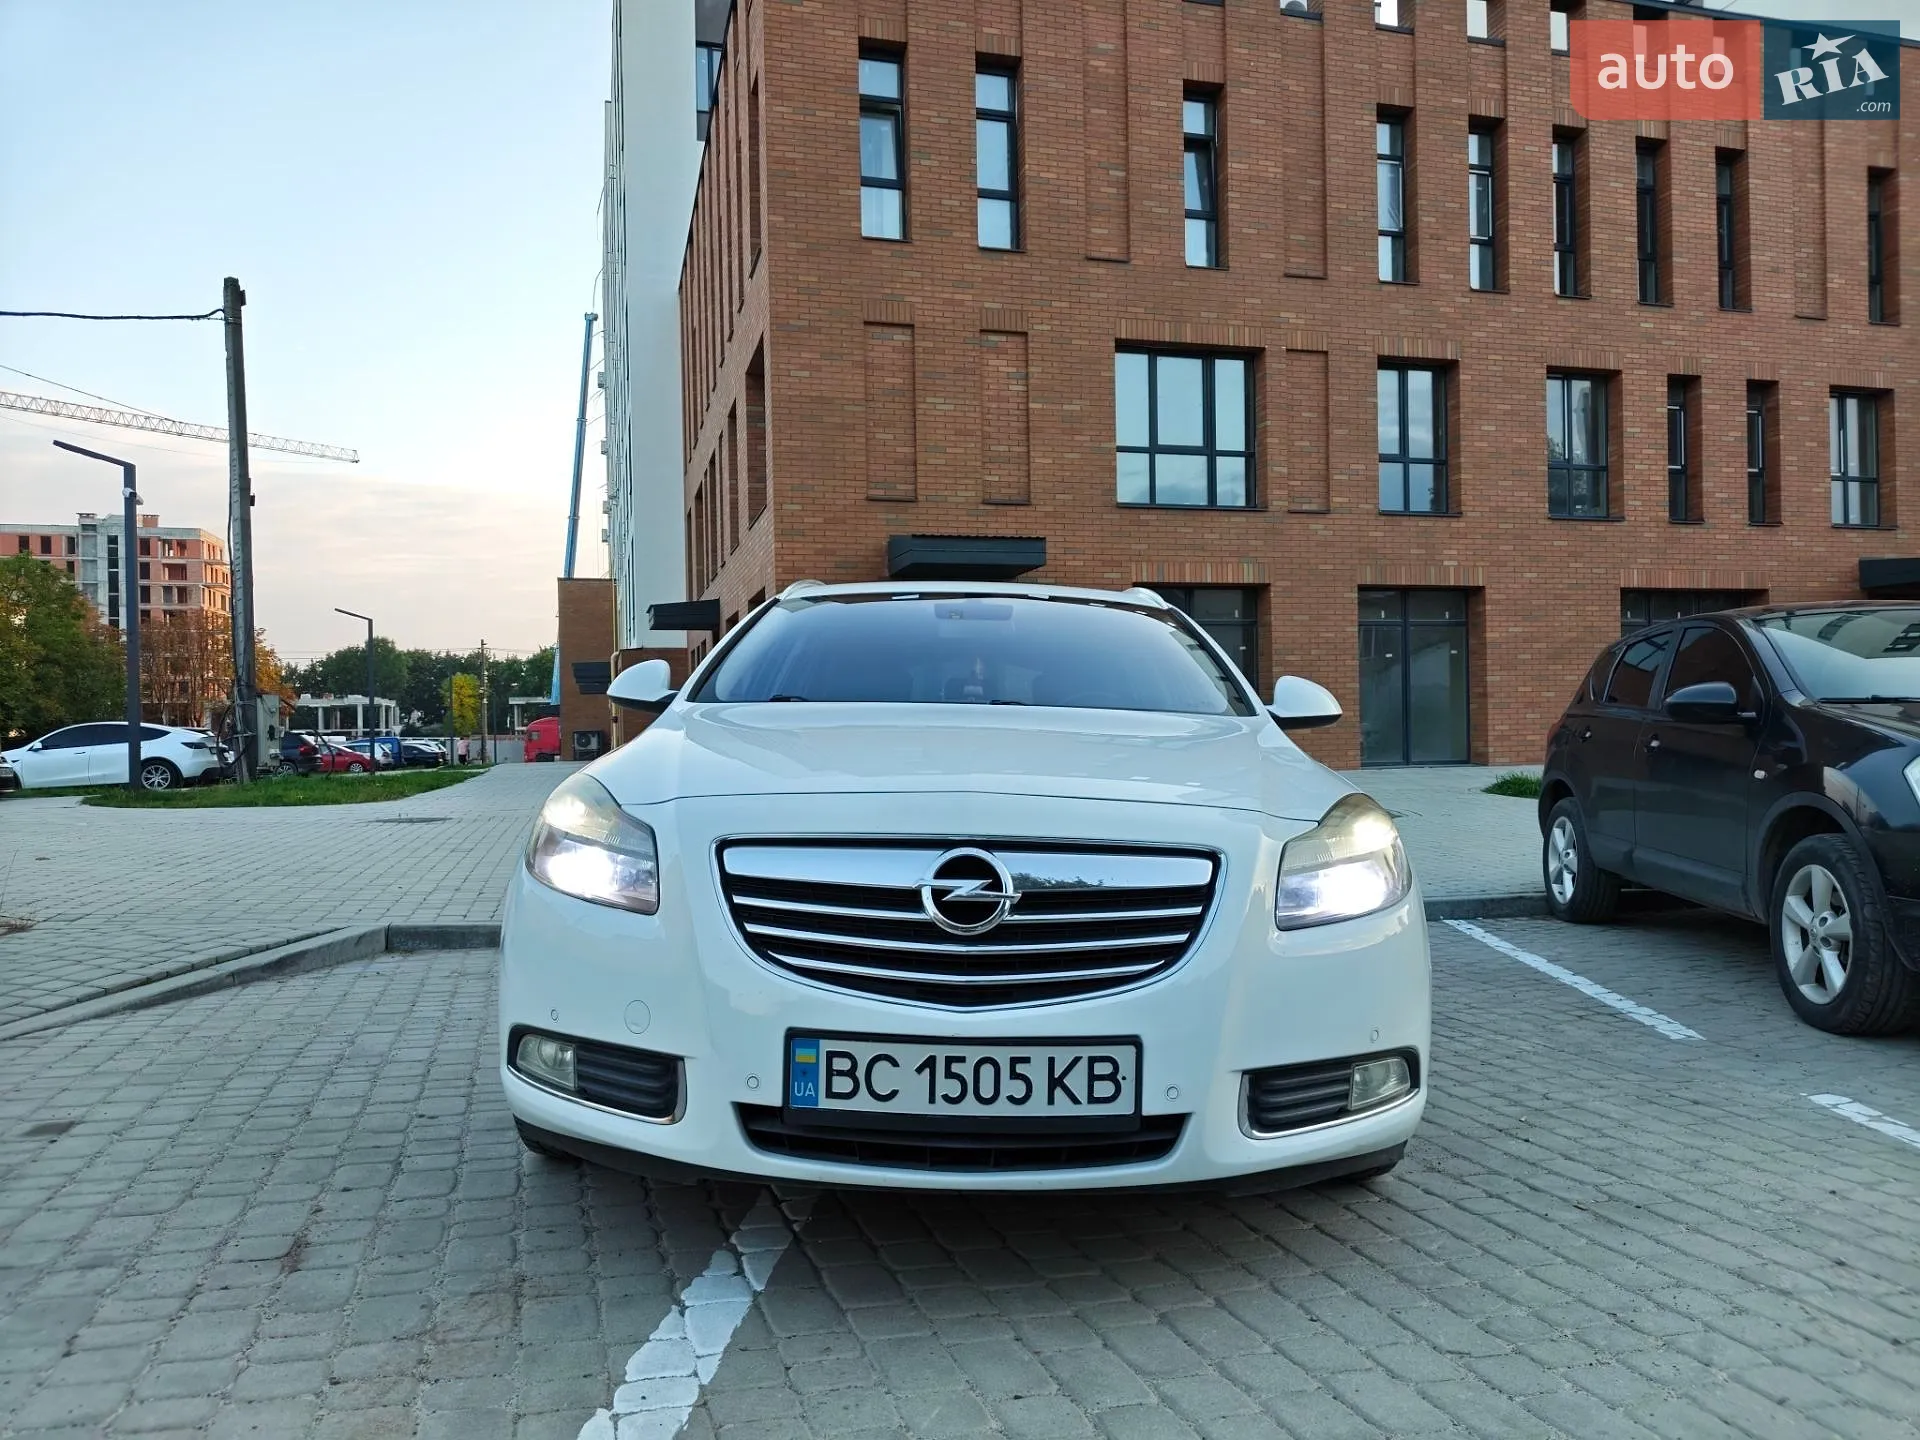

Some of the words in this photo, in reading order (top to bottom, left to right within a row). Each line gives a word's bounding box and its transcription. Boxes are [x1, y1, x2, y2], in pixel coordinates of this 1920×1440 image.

[794, 1081, 815, 1098] UA
[825, 1050, 901, 1103] BC
[914, 1054, 1033, 1106] 1505
[1047, 1055, 1122, 1106] KB
